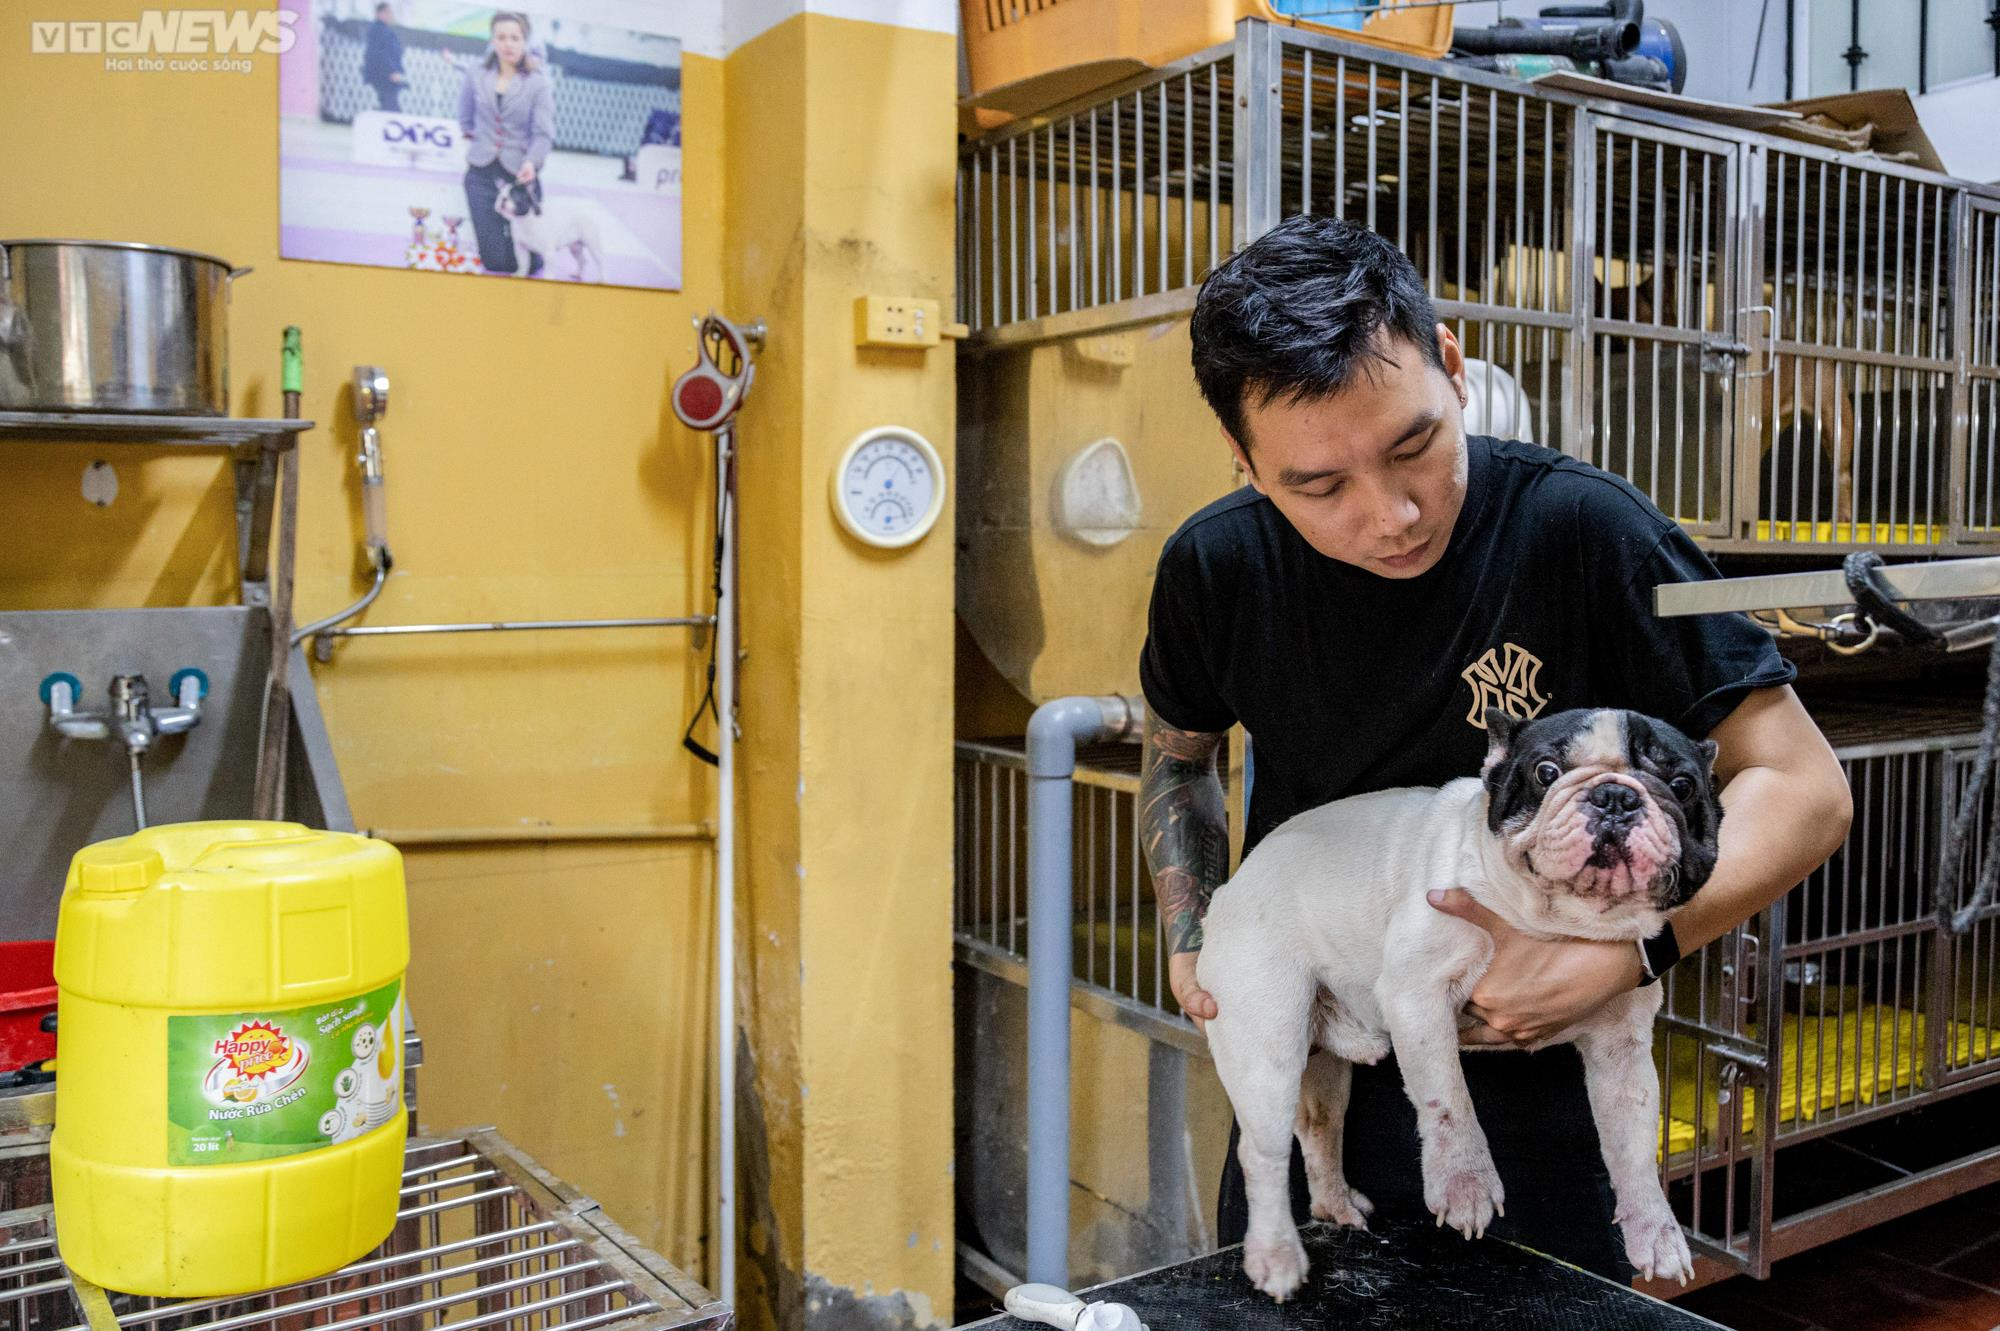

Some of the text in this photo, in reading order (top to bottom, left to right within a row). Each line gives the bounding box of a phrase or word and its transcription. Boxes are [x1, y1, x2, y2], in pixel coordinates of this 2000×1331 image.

[214, 1039, 271, 1056] Happy
[239, 1052, 273, 1072] price
[208, 1087, 307, 1120] Nước Rửa Chén
[192, 1143, 207, 1152] 20
